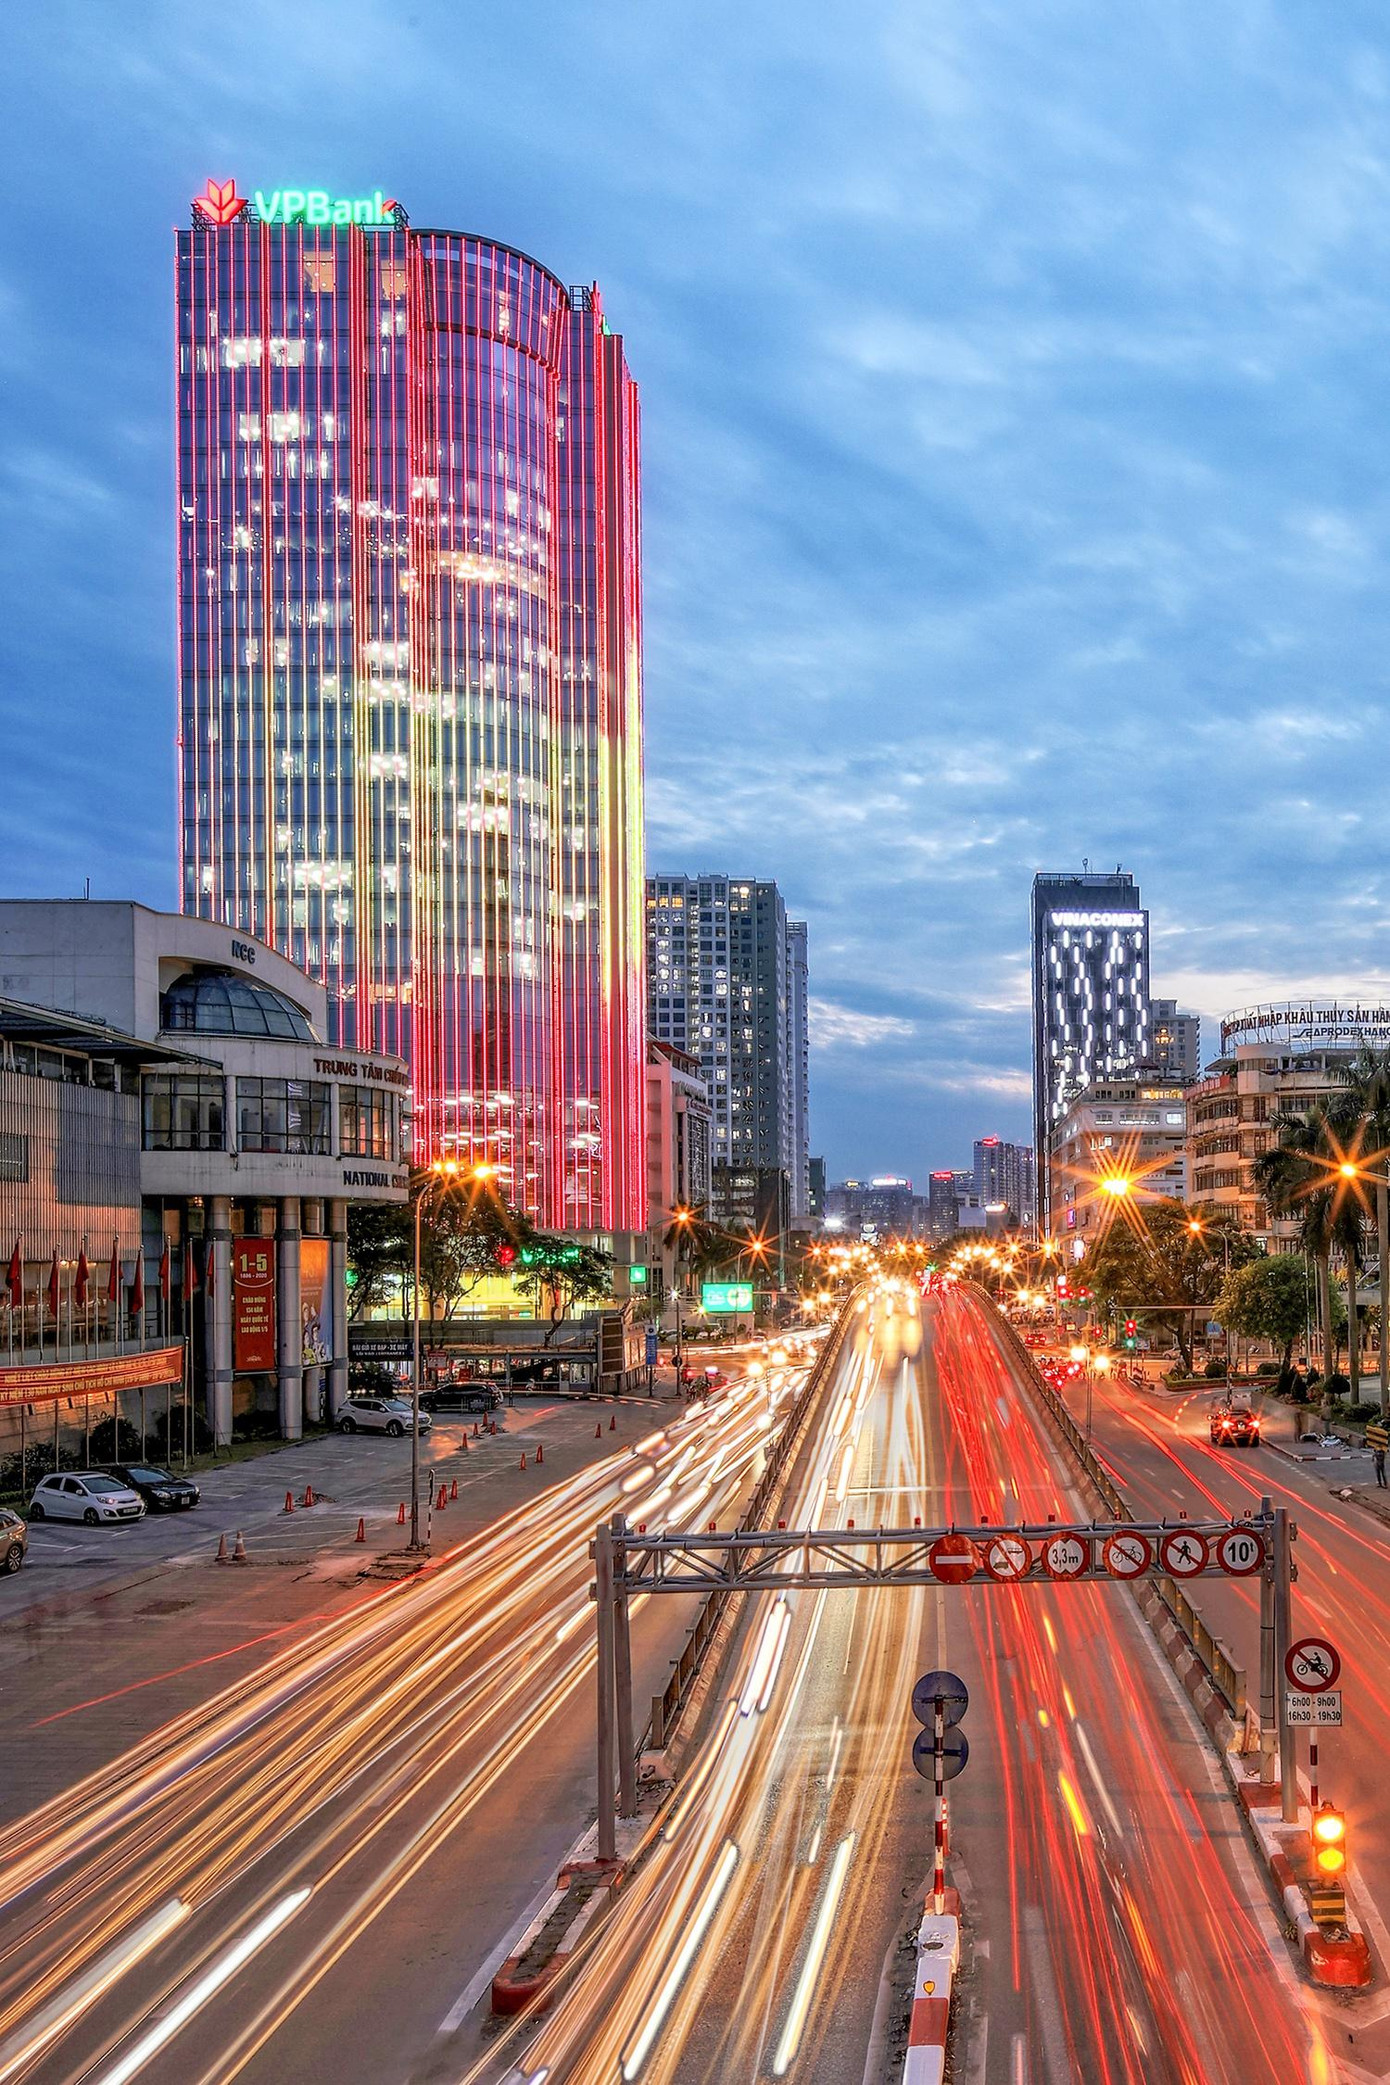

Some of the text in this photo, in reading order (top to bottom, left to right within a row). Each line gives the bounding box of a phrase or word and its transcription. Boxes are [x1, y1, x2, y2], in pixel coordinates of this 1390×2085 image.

[254, 190, 396, 225] VPBank
[1051, 912, 1144, 927] VINACONEX
[232, 940, 255, 964] NCC
[1258, 1010, 1282, 1029] NHẬP
[313, 1058, 357, 1077] TRUNG
[361, 1062, 382, 1081] TÂM
[343, 1170, 390, 1187] NATIONAL
[1052, 1548, 1079, 1566] 3,3m
[1292, 1697, 1310, 1706] 6h00
[1317, 1697, 1335, 1706] 9h00
[1289, 1711, 1311, 1721] 16h30
[1318, 1711, 1340, 1721] 19h30
